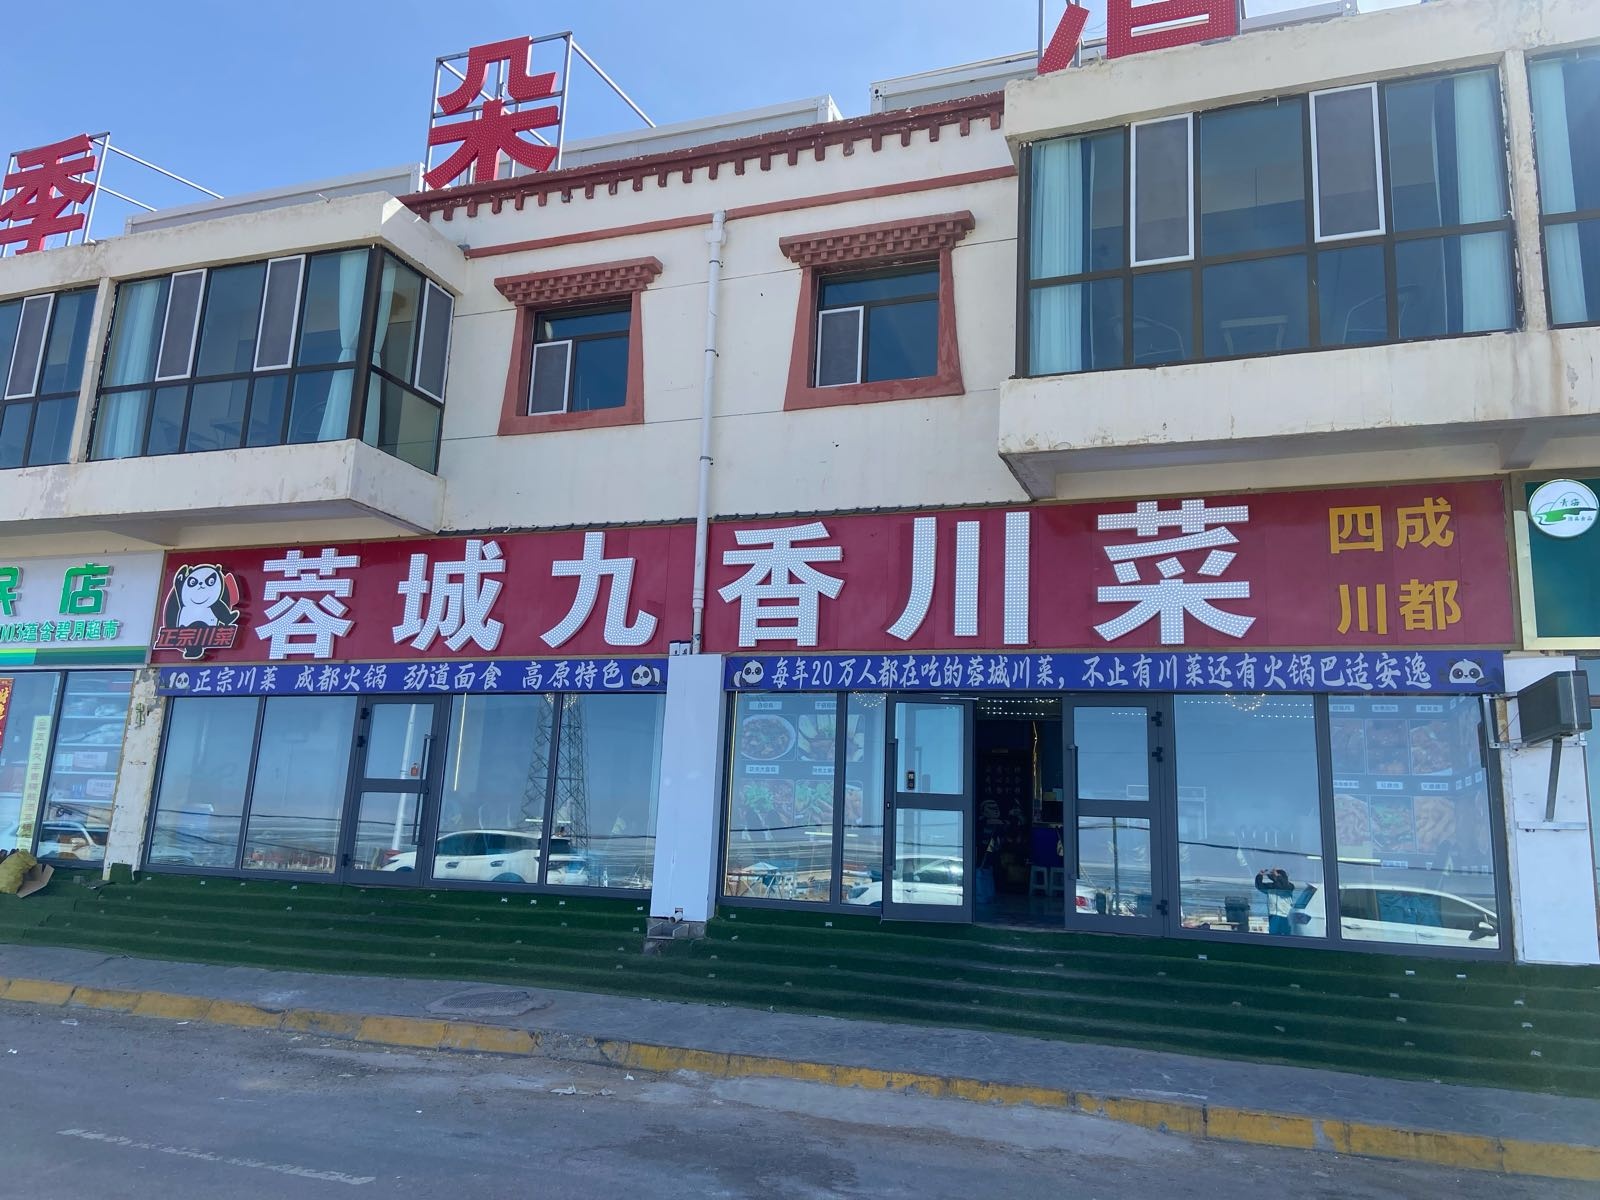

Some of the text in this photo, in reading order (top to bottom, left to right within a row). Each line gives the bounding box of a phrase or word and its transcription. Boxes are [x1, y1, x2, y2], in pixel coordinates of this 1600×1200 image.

[424, 35, 559, 190] 朵
[255, 499, 1256, 660] 蓉城九香川菜
[156, 627, 236, 647] 正宗川菜
[192, 659, 624, 693] 正宗川菜 成都火锅 劲道面食 高原特色
